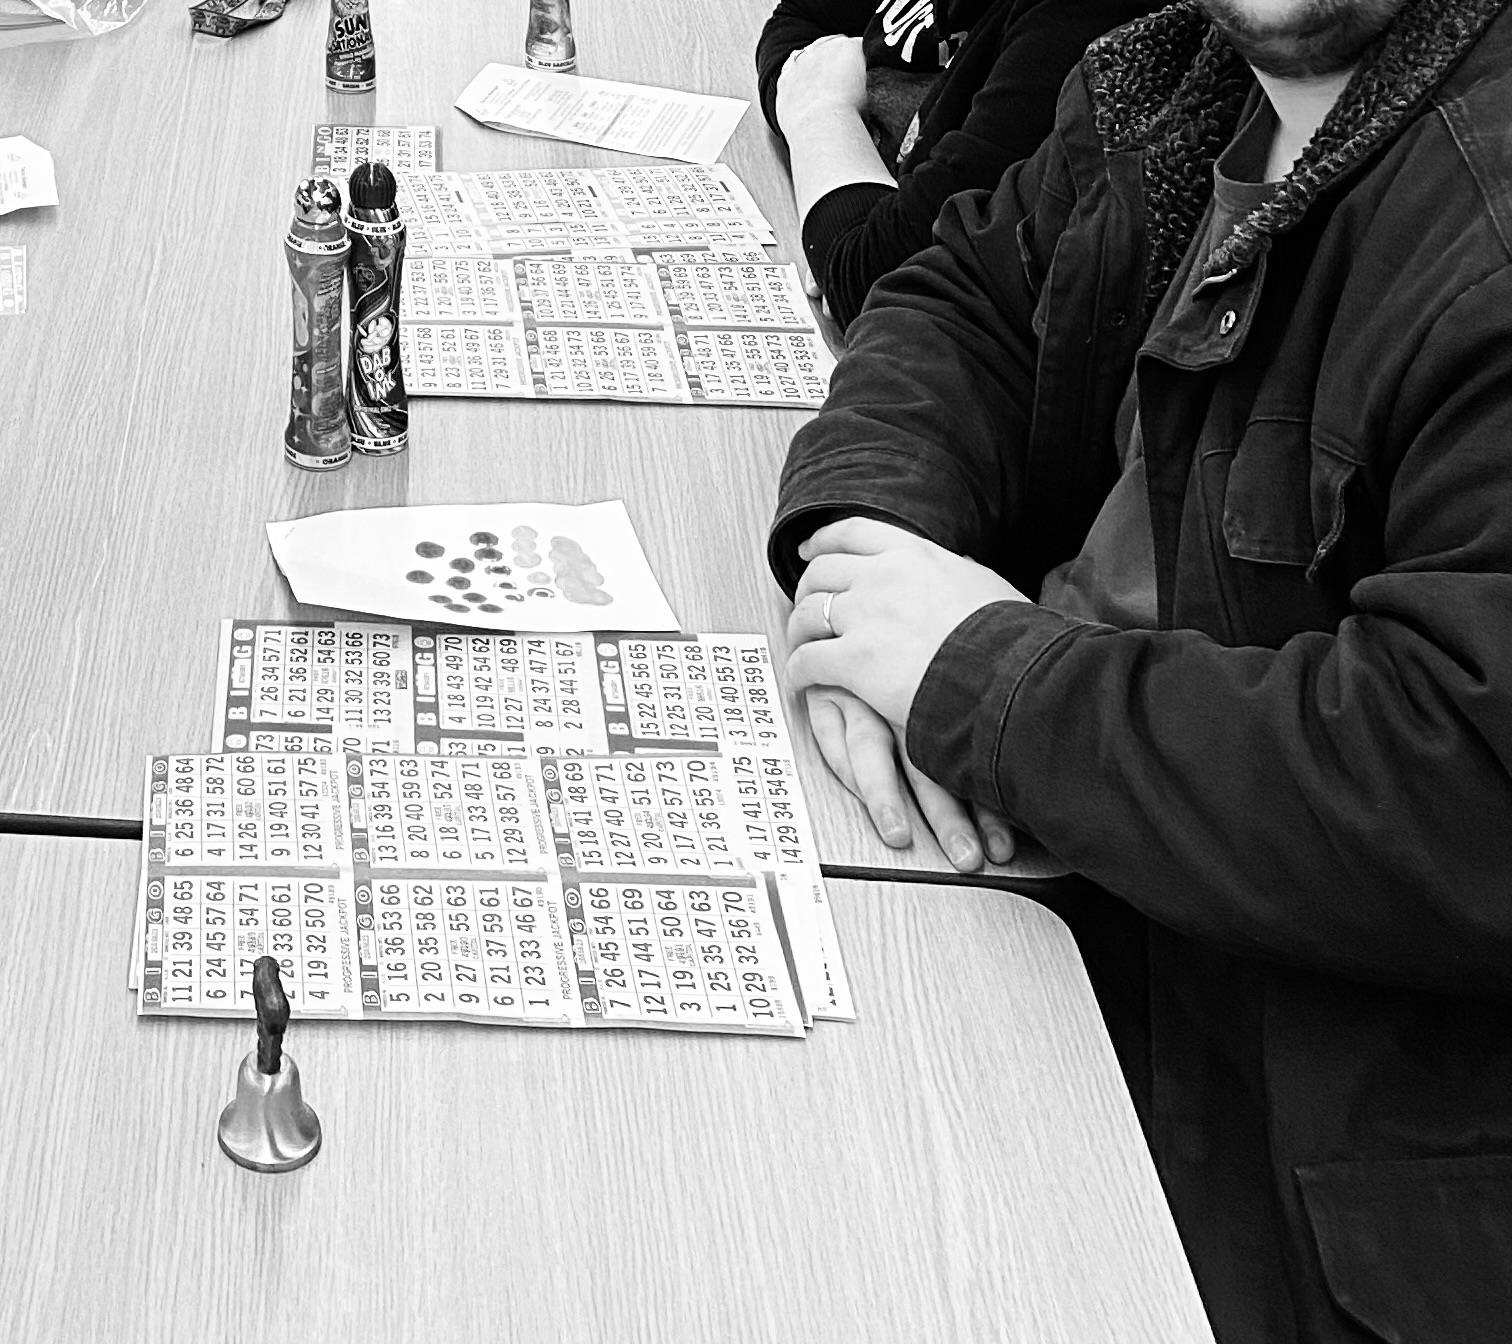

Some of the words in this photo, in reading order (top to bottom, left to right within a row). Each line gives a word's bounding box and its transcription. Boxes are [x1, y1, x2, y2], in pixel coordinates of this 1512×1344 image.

[335, 14, 368, 39] SUN
[360, 346, 391, 375] DAB
[375, 370, 385, 383] O
[367, 371, 397, 401] INK
[176, 758, 194, 774] 64
[206, 757, 224, 772] 72
[237, 756, 254, 773] 66
[267, 758, 285, 775] 61
[299, 757, 316, 775] 75
[176, 778, 194, 794] 48
[207, 777, 224, 795] 58
[237, 778, 255, 796] 60
[269, 780, 287, 797] 51
[300, 780, 318, 797] 57
[176, 800, 193, 816] 36
[207, 802, 225, 816] 31
[269, 802, 287, 818] 40
[301, 804, 319, 820] 41
[176, 822, 193, 838] 25
[208, 823, 226, 837] 17
[239, 823, 257, 839] 26
[270, 823, 288, 837] 19
[303, 824, 320, 840] 30
[176, 848, 193, 856] 6
[208, 848, 225, 856] 4
[240, 844, 258, 860] 14
[272, 848, 290, 856] 9
[304, 844, 323, 860] 12
[381, 884, 400, 905] 66
[414, 885, 434, 906] 62
[446, 885, 466, 907] 63
[481, 887, 500, 907] 61
[514, 887, 533, 908] 67
[338, 899, 349, 932] JACKPOT
[383, 911, 403, 931] 53
[417, 913, 436, 931] 58
[450, 913, 469, 932] 55
[484, 914, 503, 933] 59
[518, 915, 536, 933] 46
[547, 901, 560, 936] JACKPOT
[385, 937, 405, 957] 36
[420, 937, 439, 955] 35
[487, 940, 507, 958] 37
[520, 940, 540, 959] 33
[340, 936, 353, 994] PROGRESSIVE
[388, 963, 407, 981] 16
[422, 962, 442, 981] 20
[456, 964, 476, 982] 27
[557, 938, 571, 1000] PROGRESSIVE
[491, 965, 512, 984] 21
[526, 966, 546, 986] 23
[390, 993, 410, 1002] 5
[425, 993, 444, 1002] 2
[459, 994, 479, 1003] 9
[494, 995, 514, 1005] 6
